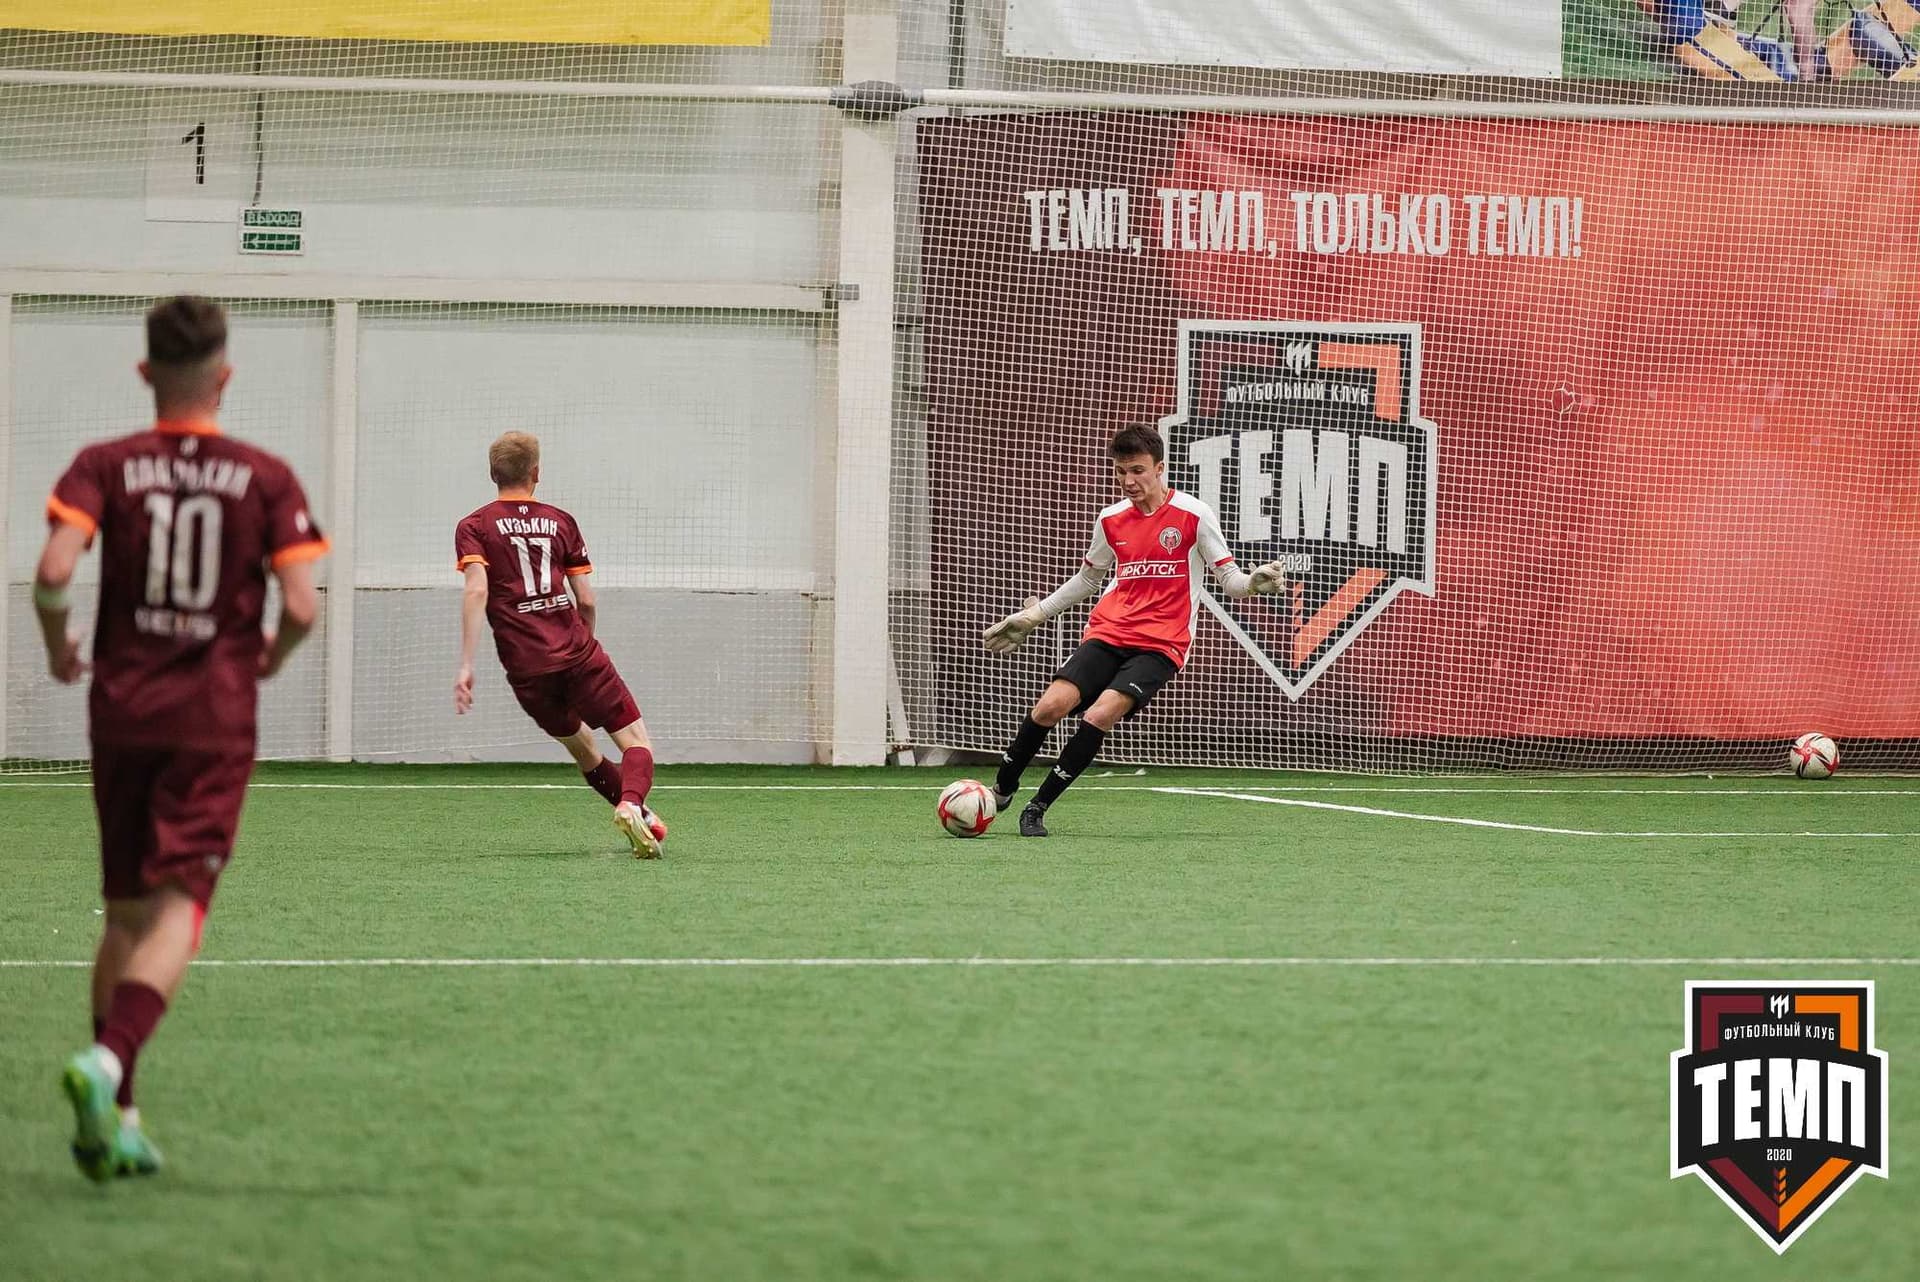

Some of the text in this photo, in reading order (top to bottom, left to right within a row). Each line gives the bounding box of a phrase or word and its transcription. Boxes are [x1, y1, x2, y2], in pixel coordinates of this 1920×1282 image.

[181, 122, 205, 185] 1
[246, 212, 300, 225] ВЫХОД
[1024, 188, 1582, 259] ТЕМП, ТЕМП, ТОЛЬКО ТЕМП!
[1227, 380, 1369, 406] ФУТБОЛЬНЫЙ КЛУБ
[1189, 429, 1408, 555] ТЕМП
[144, 493, 223, 611] 10
[495, 517, 558, 537] КУЗЬКИН
[509, 536, 552, 597] 17
[1279, 553, 1311, 571] 2020
